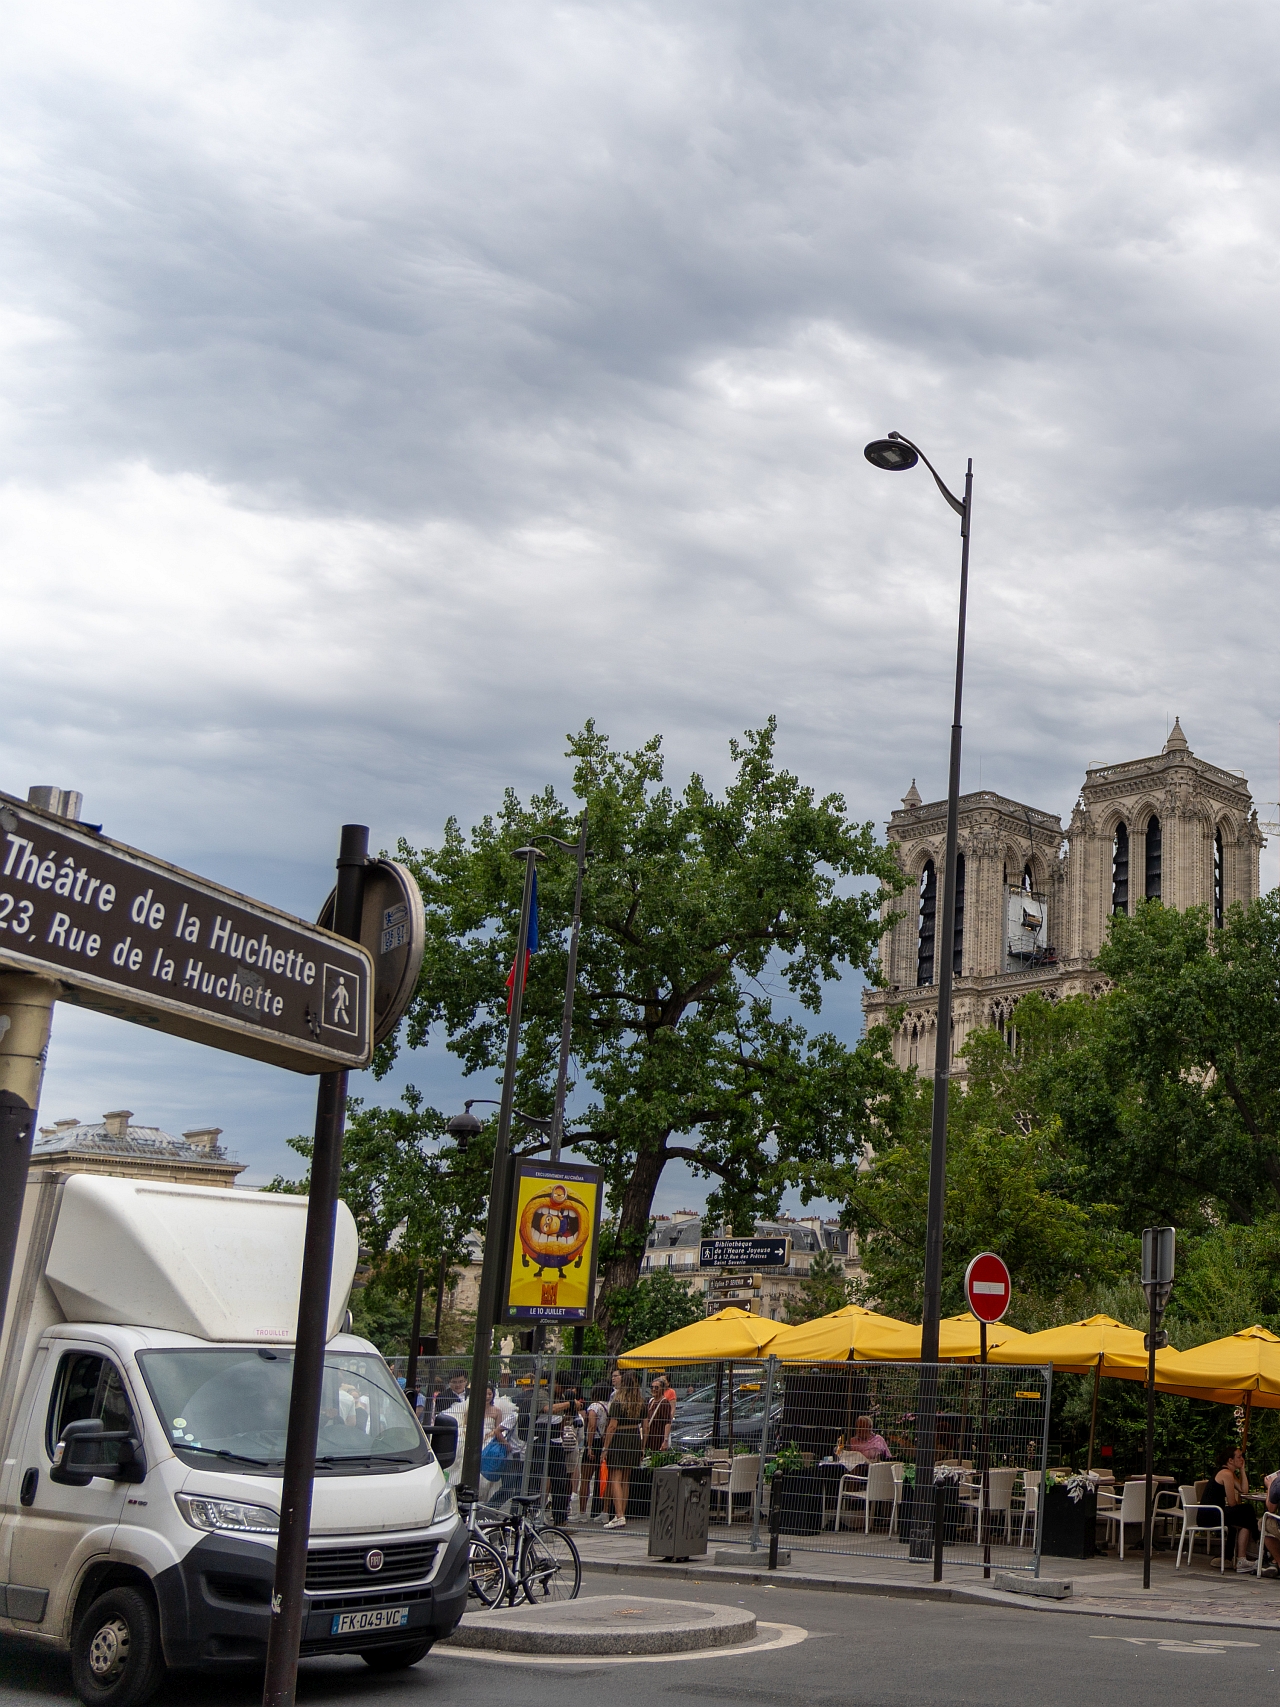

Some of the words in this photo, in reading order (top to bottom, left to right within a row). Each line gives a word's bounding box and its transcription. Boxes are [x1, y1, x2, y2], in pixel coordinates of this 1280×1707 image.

[4, 832, 116, 912] Théâtre
[131, 888, 165, 930] de
[175, 902, 201, 944] la
[210, 915, 316, 986] Huchette
[47, 911, 102, 957] Rue
[112, 936, 143, 971] de
[152, 947, 175, 982] la
[182, 957, 284, 1017] Huchette
[529, 1307, 537, 1315] LE
[537, 1307, 544, 1315] 10
[255, 1329, 290, 1337] TROUILLET
[370, 1555, 381, 1566] FIAT
[340, 1609, 401, 1631] FK-049-VC
